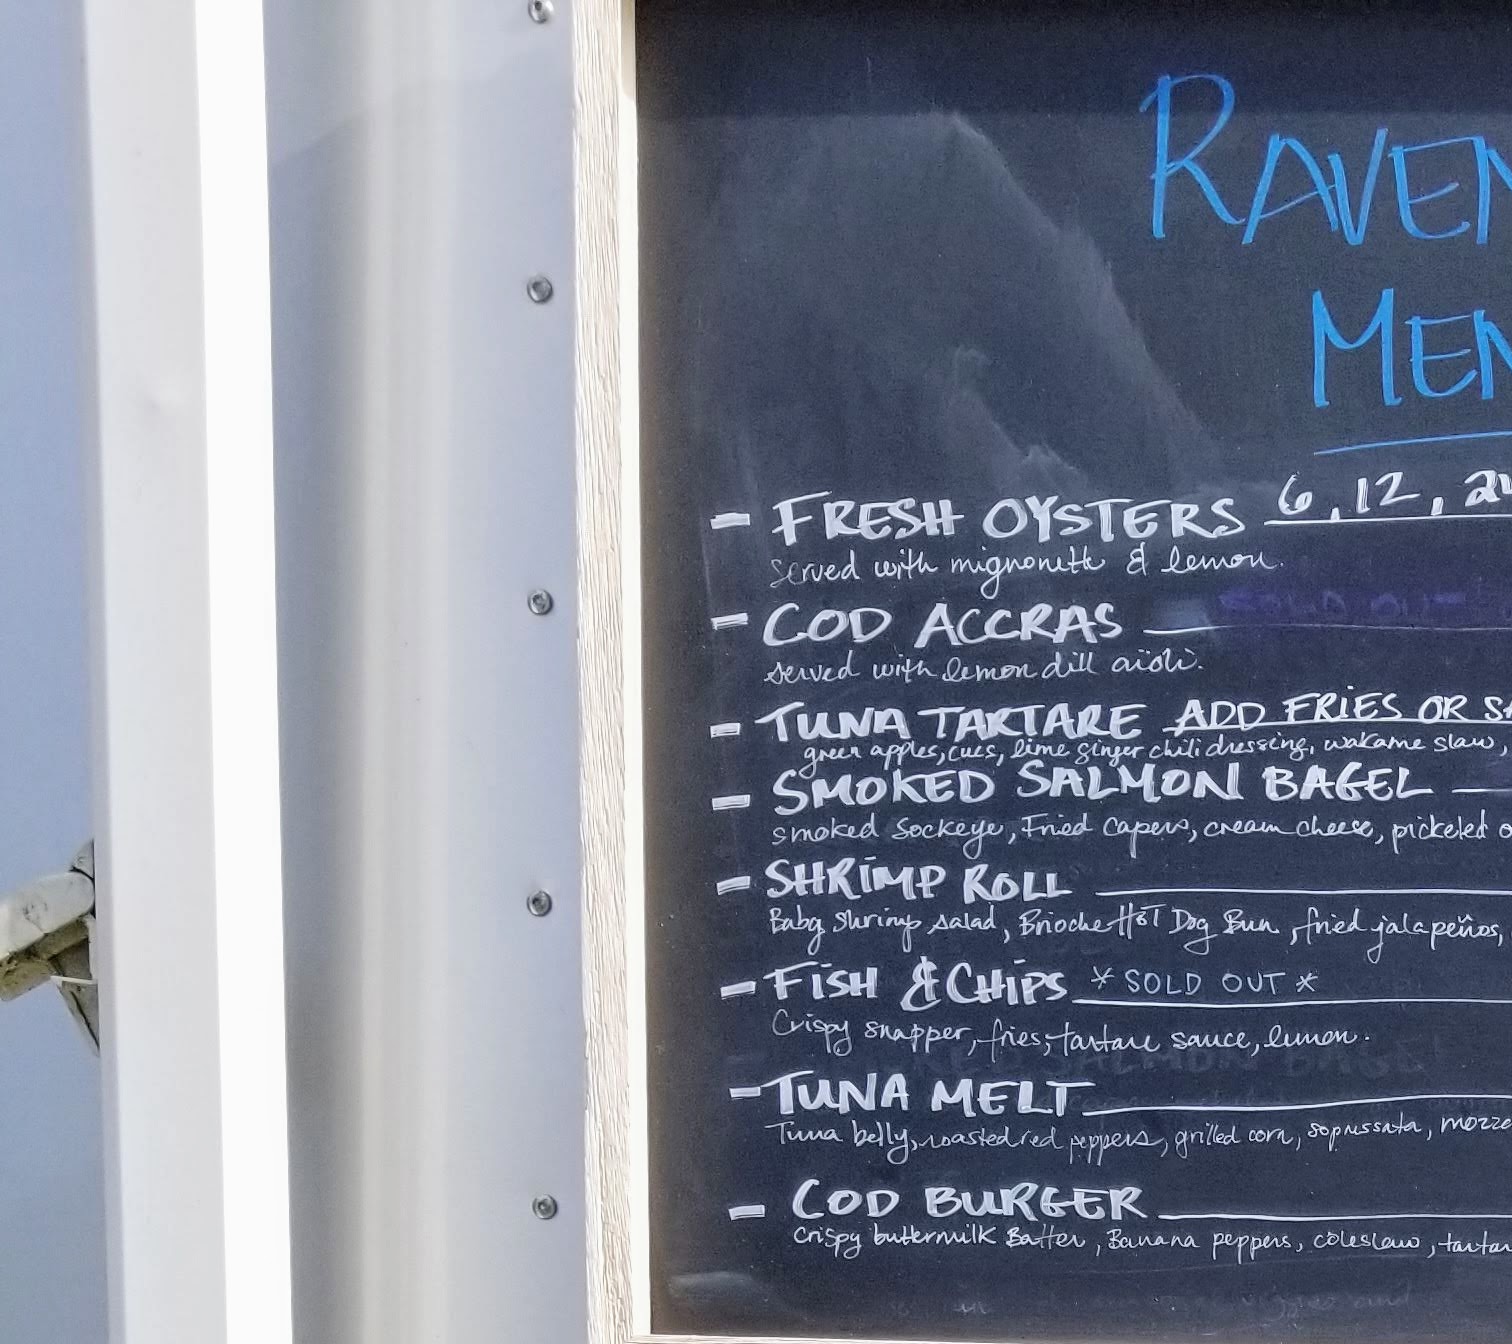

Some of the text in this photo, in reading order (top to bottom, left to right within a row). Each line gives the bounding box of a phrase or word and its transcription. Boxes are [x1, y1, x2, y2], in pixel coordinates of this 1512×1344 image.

[771, 490, 964, 545] FRESH
[982, 495, 1246, 543] OYSTERS
[769, 549, 859, 588] served
[874, 554, 939, 578] with
[762, 604, 892, 646] COD
[914, 602, 1122, 648] ACCRAS
[764, 652, 1096, 683] served with lemon dill
[755, 702, 911, 741] TUNA
[917, 704, 1147, 739] TARTARE
[1175, 697, 1267, 730] ADD
[1284, 686, 1402, 722] FRIES
[1418, 694, 1467, 723] OR
[803, 743, 862, 779] green
[870, 739, 946, 771] apples,
[1010, 738, 1070, 760] lime
[1076, 741, 1145, 766] ginger
[1149, 739, 1202, 760] chili
[1199, 733, 1316, 758] dressing,
[772, 769, 995, 814] SMOKED
[1016, 760, 1244, 802] SALMON
[1264, 764, 1433, 800] BAGEL
[773, 817, 879, 845] smoked
[1203, 815, 1295, 836] cream
[765, 857, 946, 899] SHRIMP
[962, 864, 1073, 903] ROLL
[770, 906, 827, 954] Baby
[1019, 911, 1113, 935] Brioche
[1170, 908, 1218, 954] Dog
[763, 961, 878, 999] FISH
[1125, 970, 1202, 995] SOLD
[1222, 973, 1286, 993] OUT
[1172, 1031, 1260, 1056] sauce,
[759, 1071, 909, 1115] TUNA
[931, 1079, 1096, 1116] MELT
[765, 1121, 844, 1146] Tuna
[1021, 1126, 1064, 1150] red
[1175, 1123, 1240, 1157] grilled
[792, 1178, 900, 1219] COD
[925, 1183, 1148, 1222] BURGER
[1108, 1227, 1201, 1250] Banana
